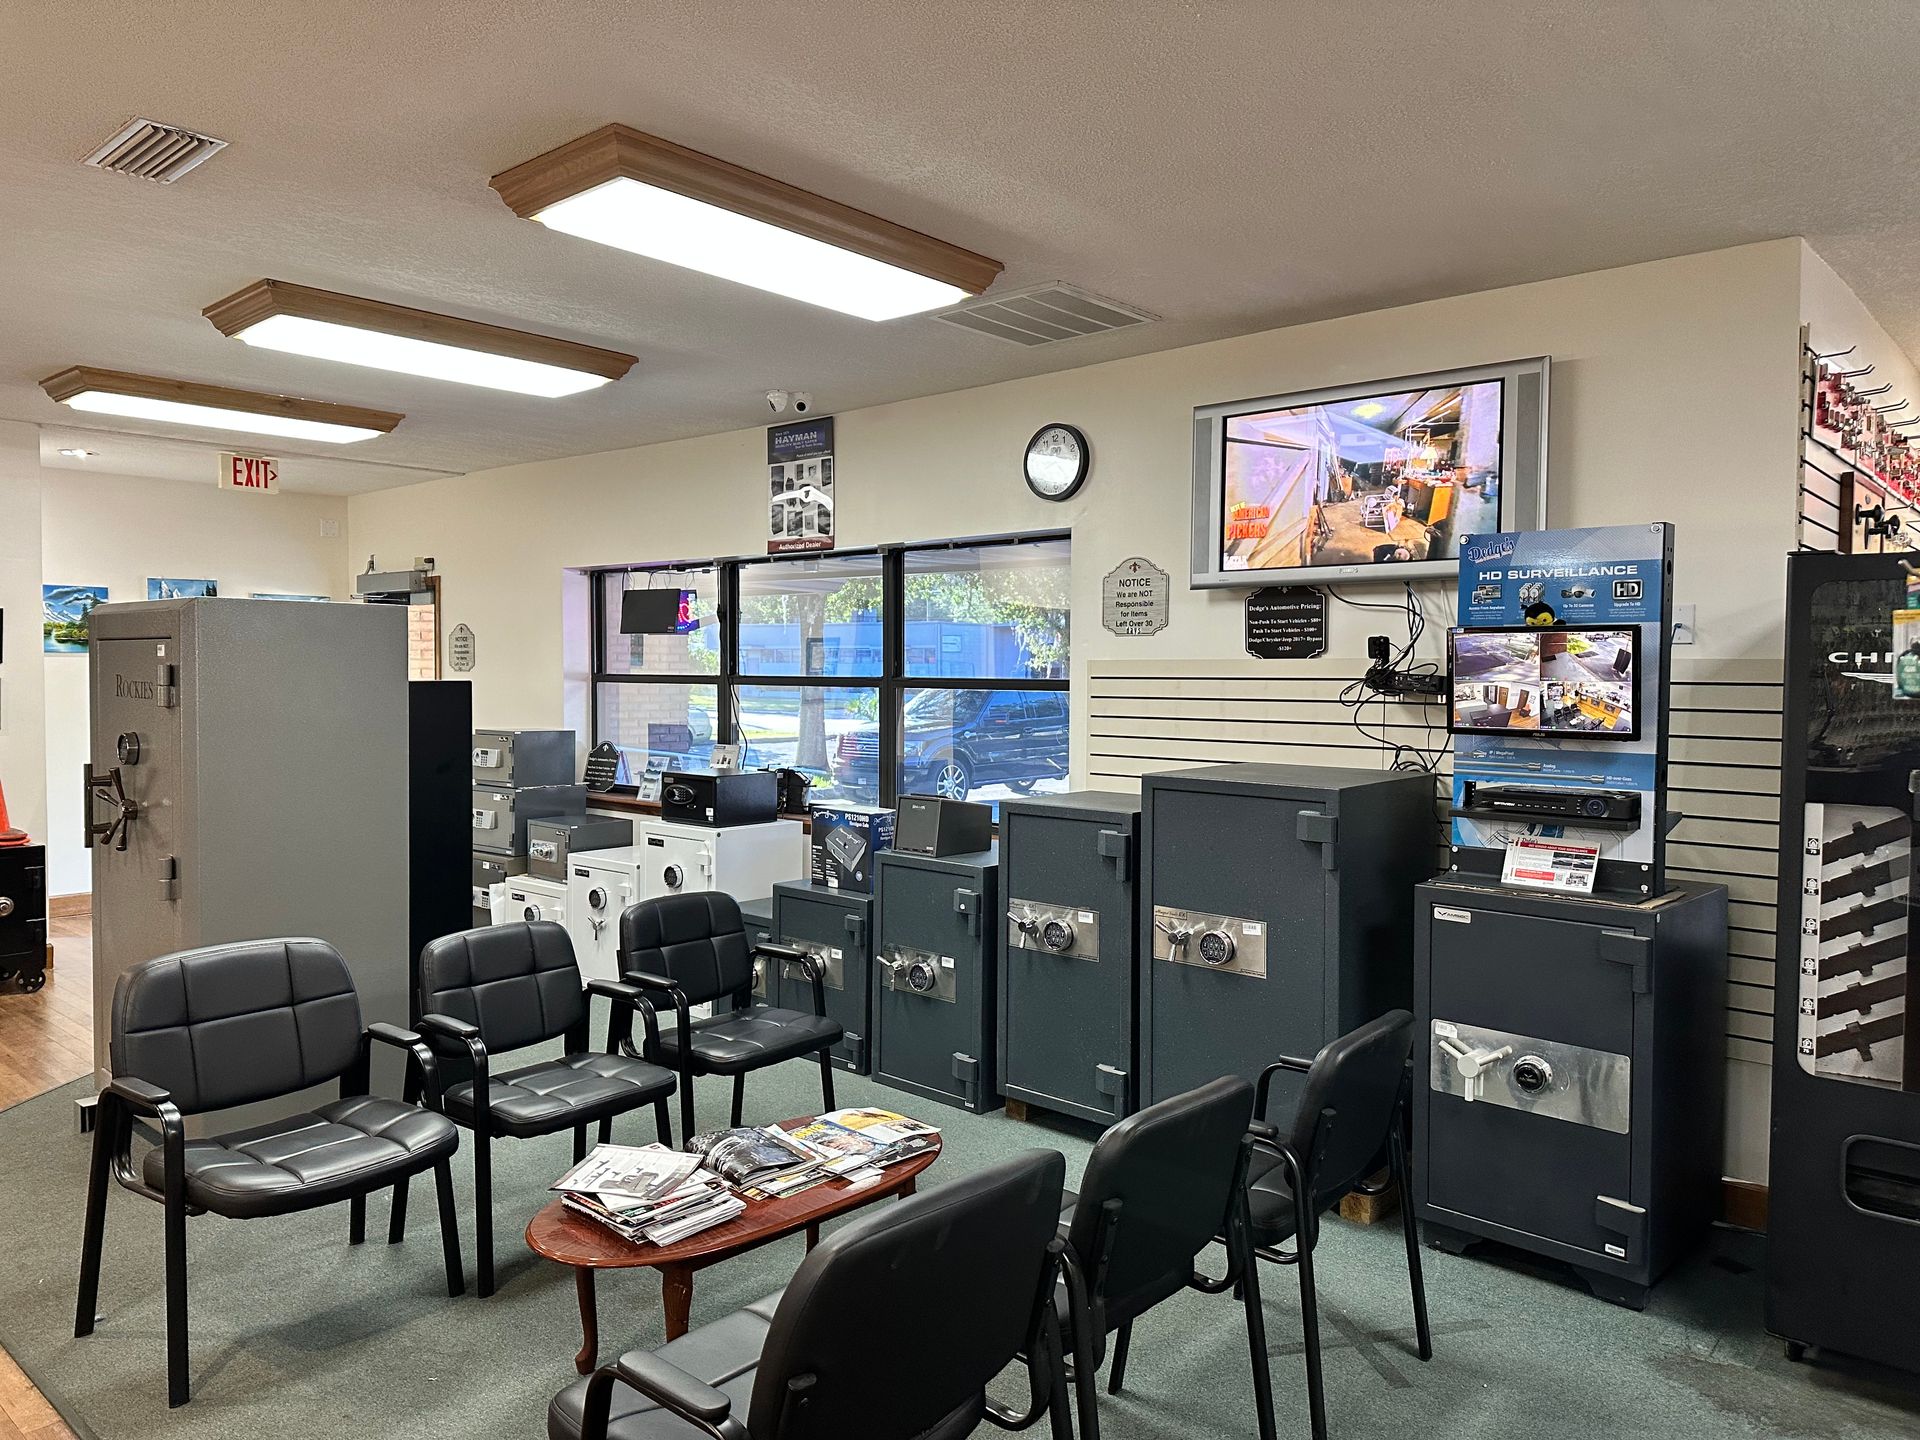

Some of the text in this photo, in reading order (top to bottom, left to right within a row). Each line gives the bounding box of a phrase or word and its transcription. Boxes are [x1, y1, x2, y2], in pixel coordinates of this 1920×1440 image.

[775, 432, 817, 444] HAYMAN
[1052, 434, 1058, 442] 12
[232, 456, 270, 488] EXIT
[1232, 506, 1270, 520] AMERICAN
[1226, 522, 1268, 540] PICKERS
[1480, 565, 1638, 580] HD SURVEILLANCE
[1119, 578, 1150, 587] NOTICE
[1616, 583, 1638, 596] HD
[116, 674, 153, 699] ROCKIES
